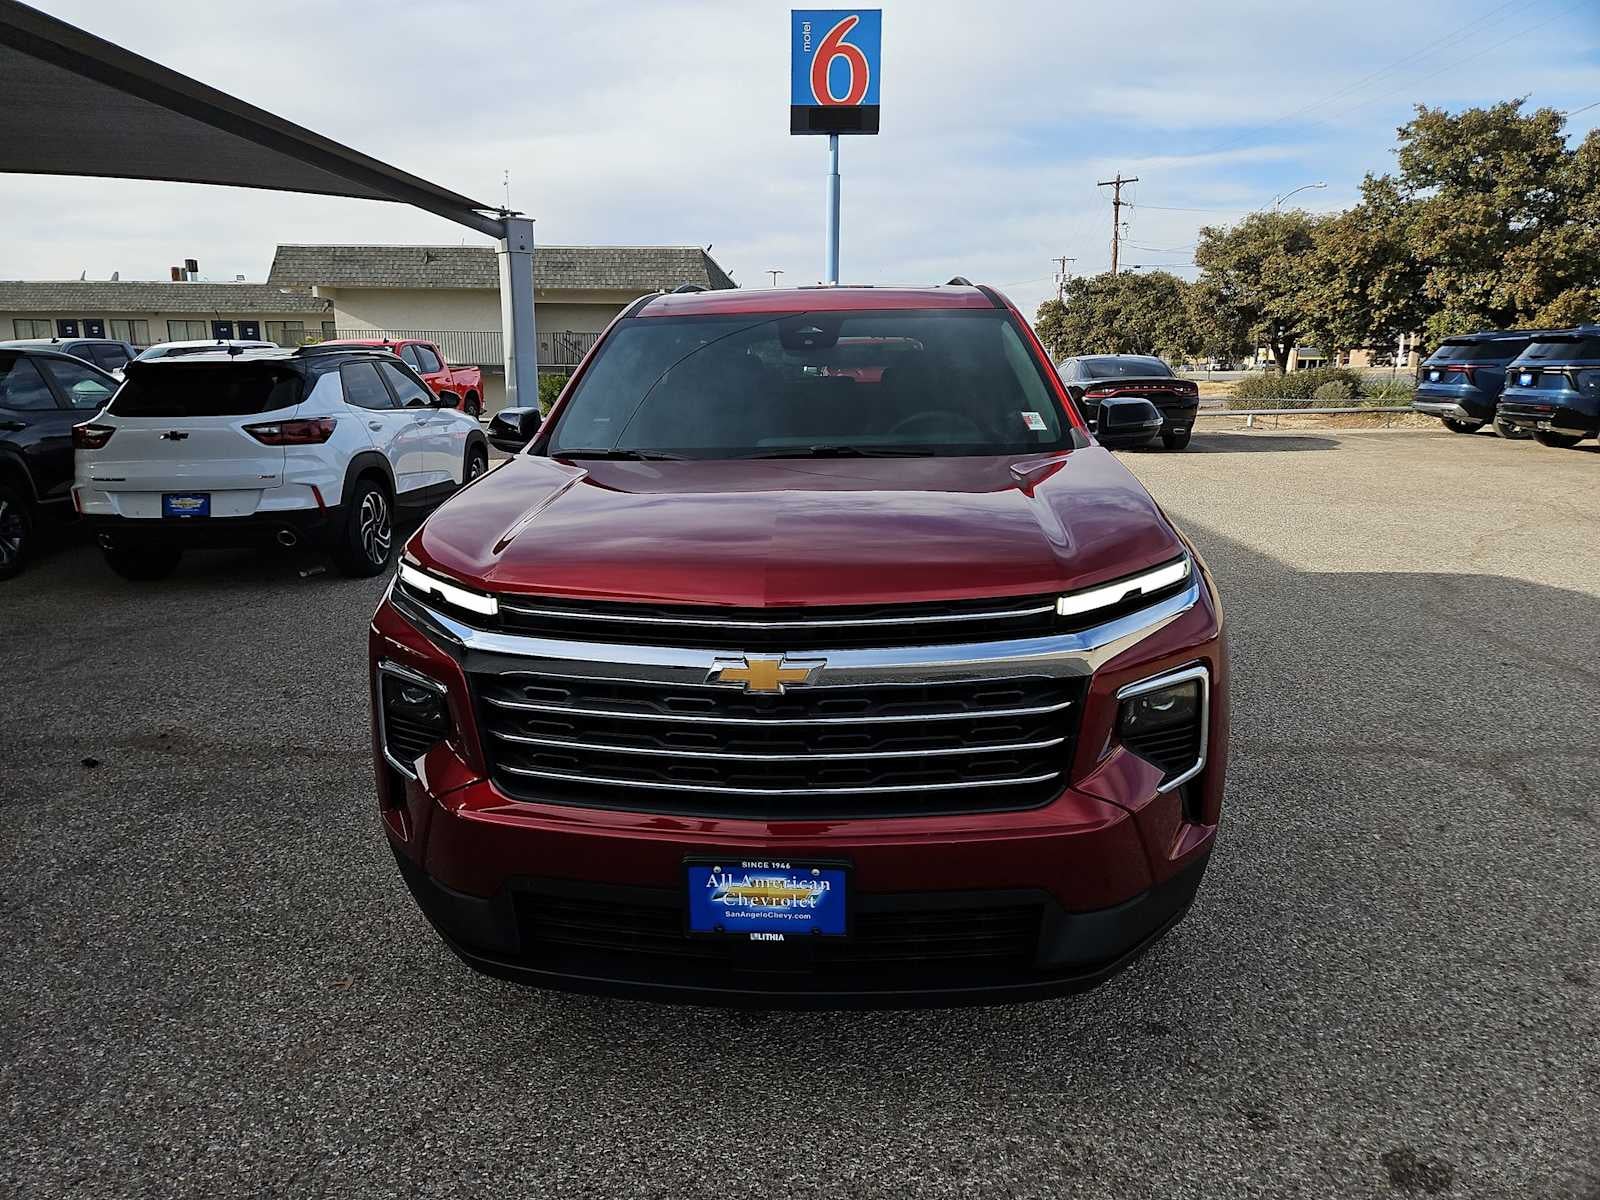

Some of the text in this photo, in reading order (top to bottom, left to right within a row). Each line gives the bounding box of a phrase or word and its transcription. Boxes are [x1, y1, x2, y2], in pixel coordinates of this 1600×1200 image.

[802, 21, 811, 52] motel
[809, 14, 870, 105] 6
[741, 861, 769, 869] SINCE
[706, 873, 831, 891] All American
[723, 892, 817, 909] Chevrolet
[725, 910, 812, 920] SanAngeloChevy.com
[758, 933, 784, 941] LITHIA
